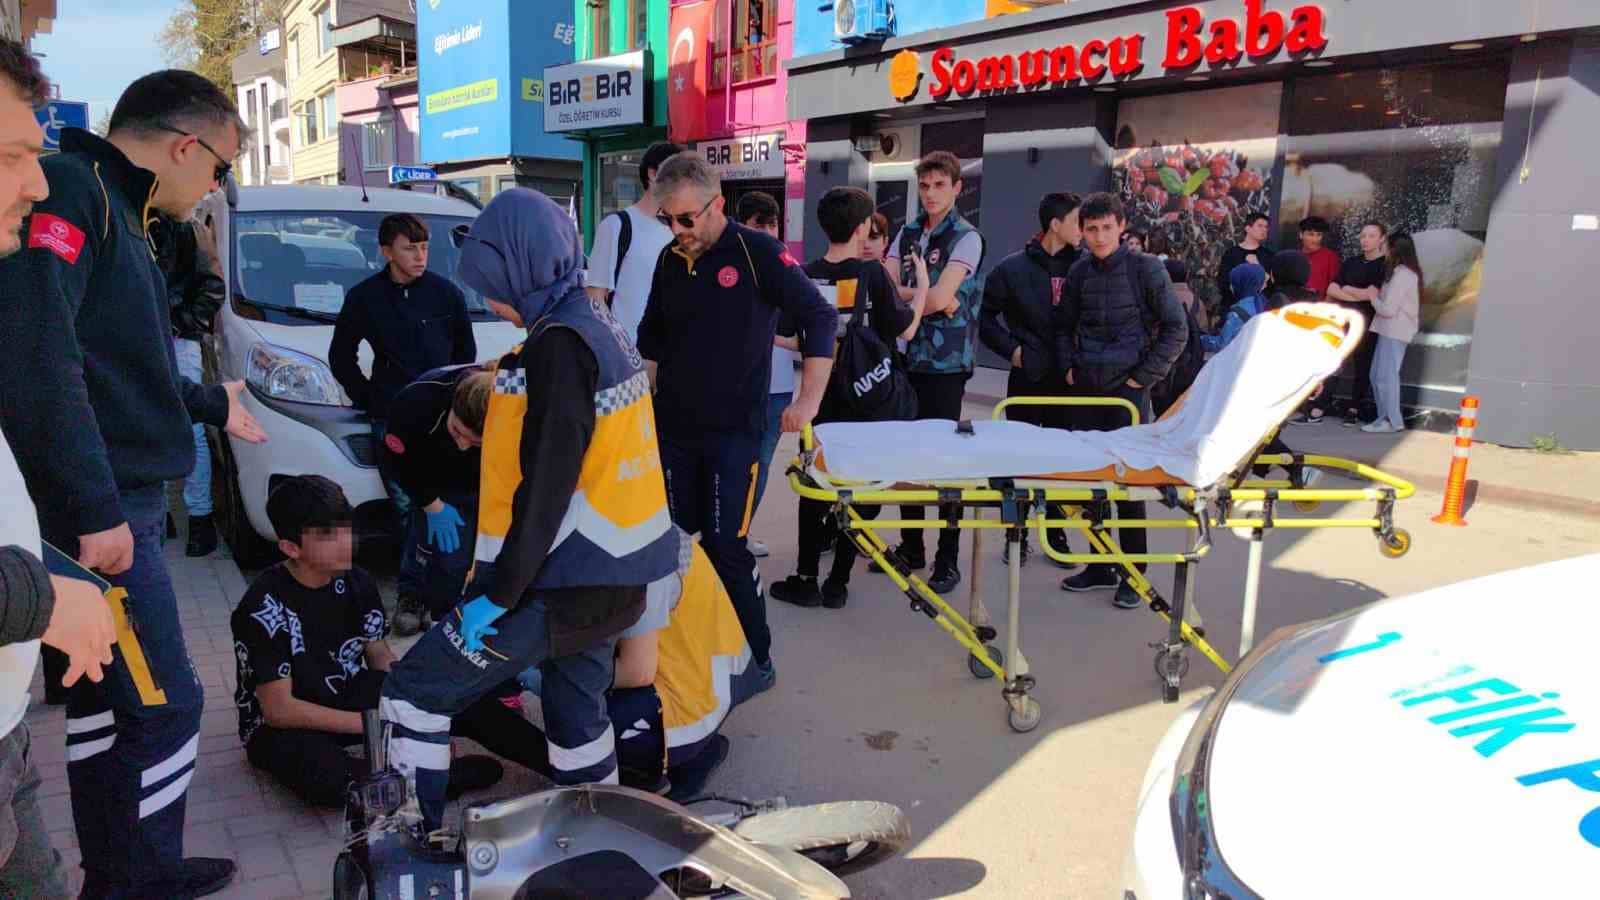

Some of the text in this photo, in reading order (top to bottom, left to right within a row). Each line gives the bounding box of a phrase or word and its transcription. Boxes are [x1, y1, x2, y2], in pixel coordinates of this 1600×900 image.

[928, 0, 1327, 98] Somuncu Baba
[853, 357, 892, 397] NASA
